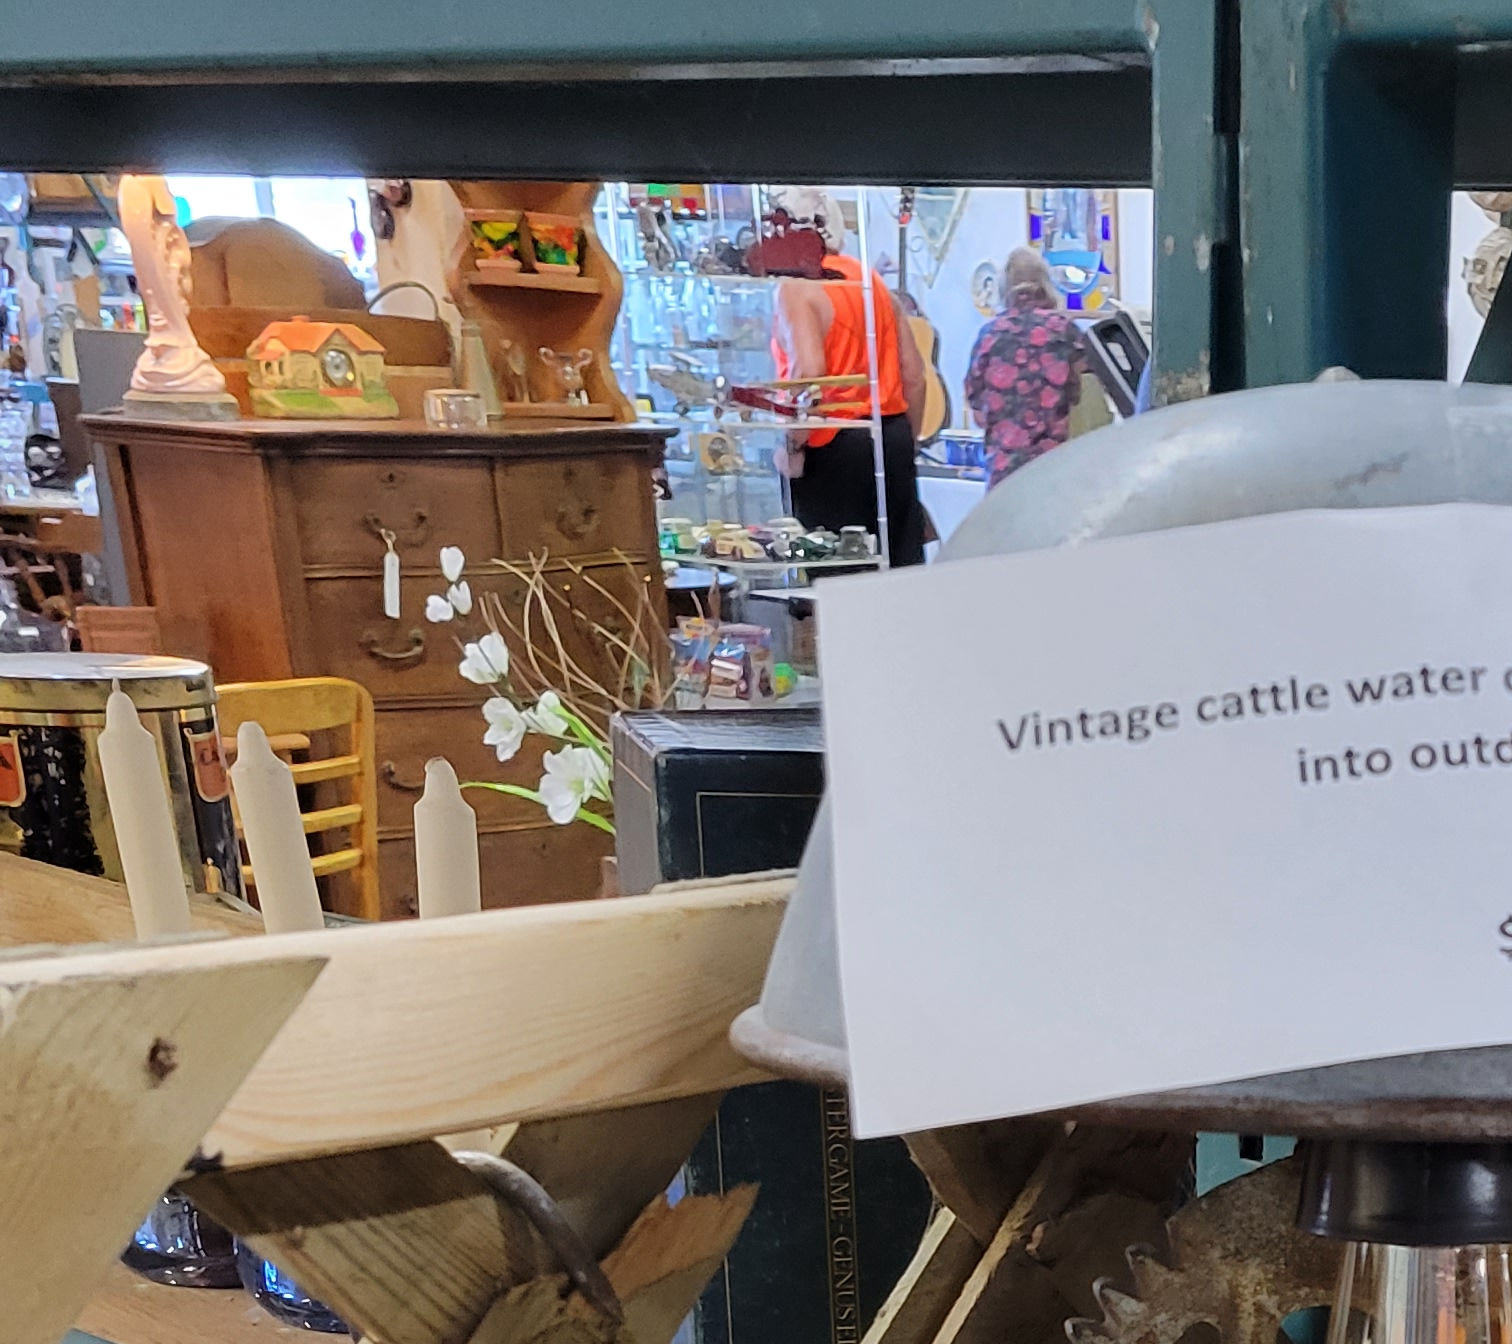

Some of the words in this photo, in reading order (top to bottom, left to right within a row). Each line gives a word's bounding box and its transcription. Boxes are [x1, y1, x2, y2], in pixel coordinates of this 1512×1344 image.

[996, 702, 1180, 752] Vintage
[1196, 676, 1330, 723] cattle
[1345, 665, 1487, 705] water
[1297, 746, 1393, 785] into
[832, 1236, 855, 1320] GENUS
